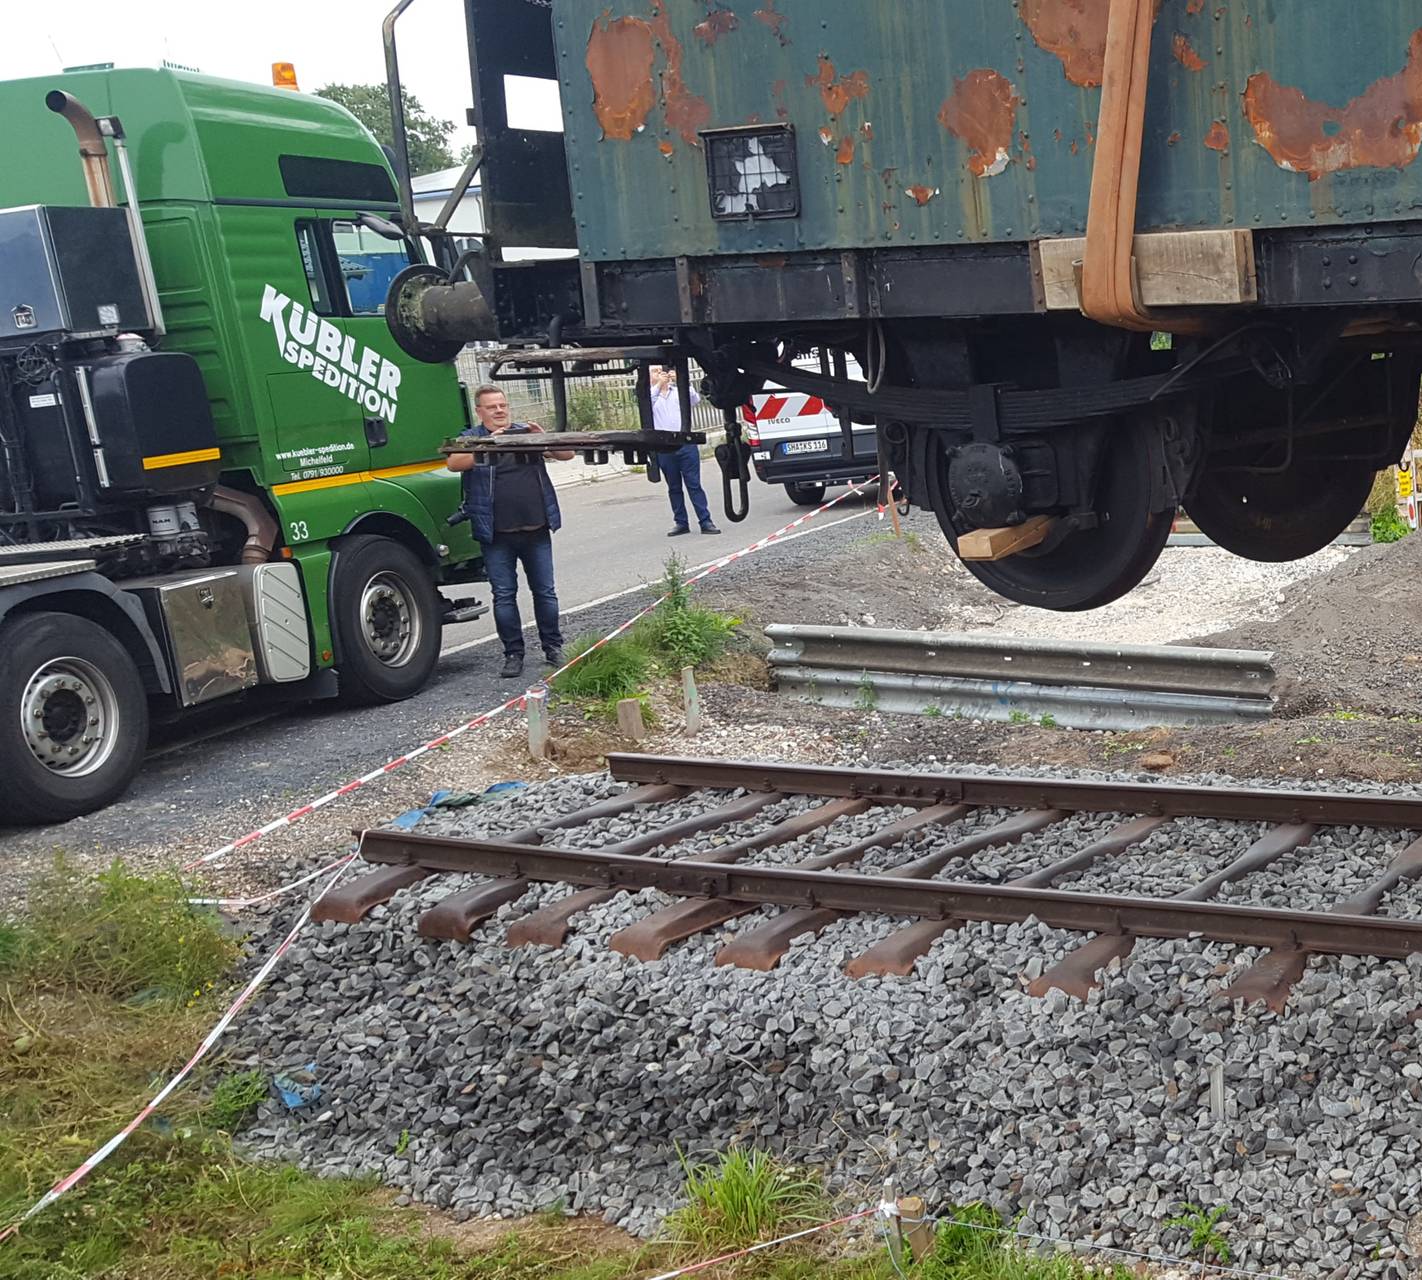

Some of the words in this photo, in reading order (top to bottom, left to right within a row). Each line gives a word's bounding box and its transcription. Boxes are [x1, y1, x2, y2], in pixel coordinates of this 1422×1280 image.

[283, 340, 398, 424] SPEDITION
[768, 417, 790, 425] IVECO
[275, 442, 355, 460] www.kuebler-spedition.de
[300, 454, 333, 467] Michelfeld
[290, 520, 309, 540] 33
